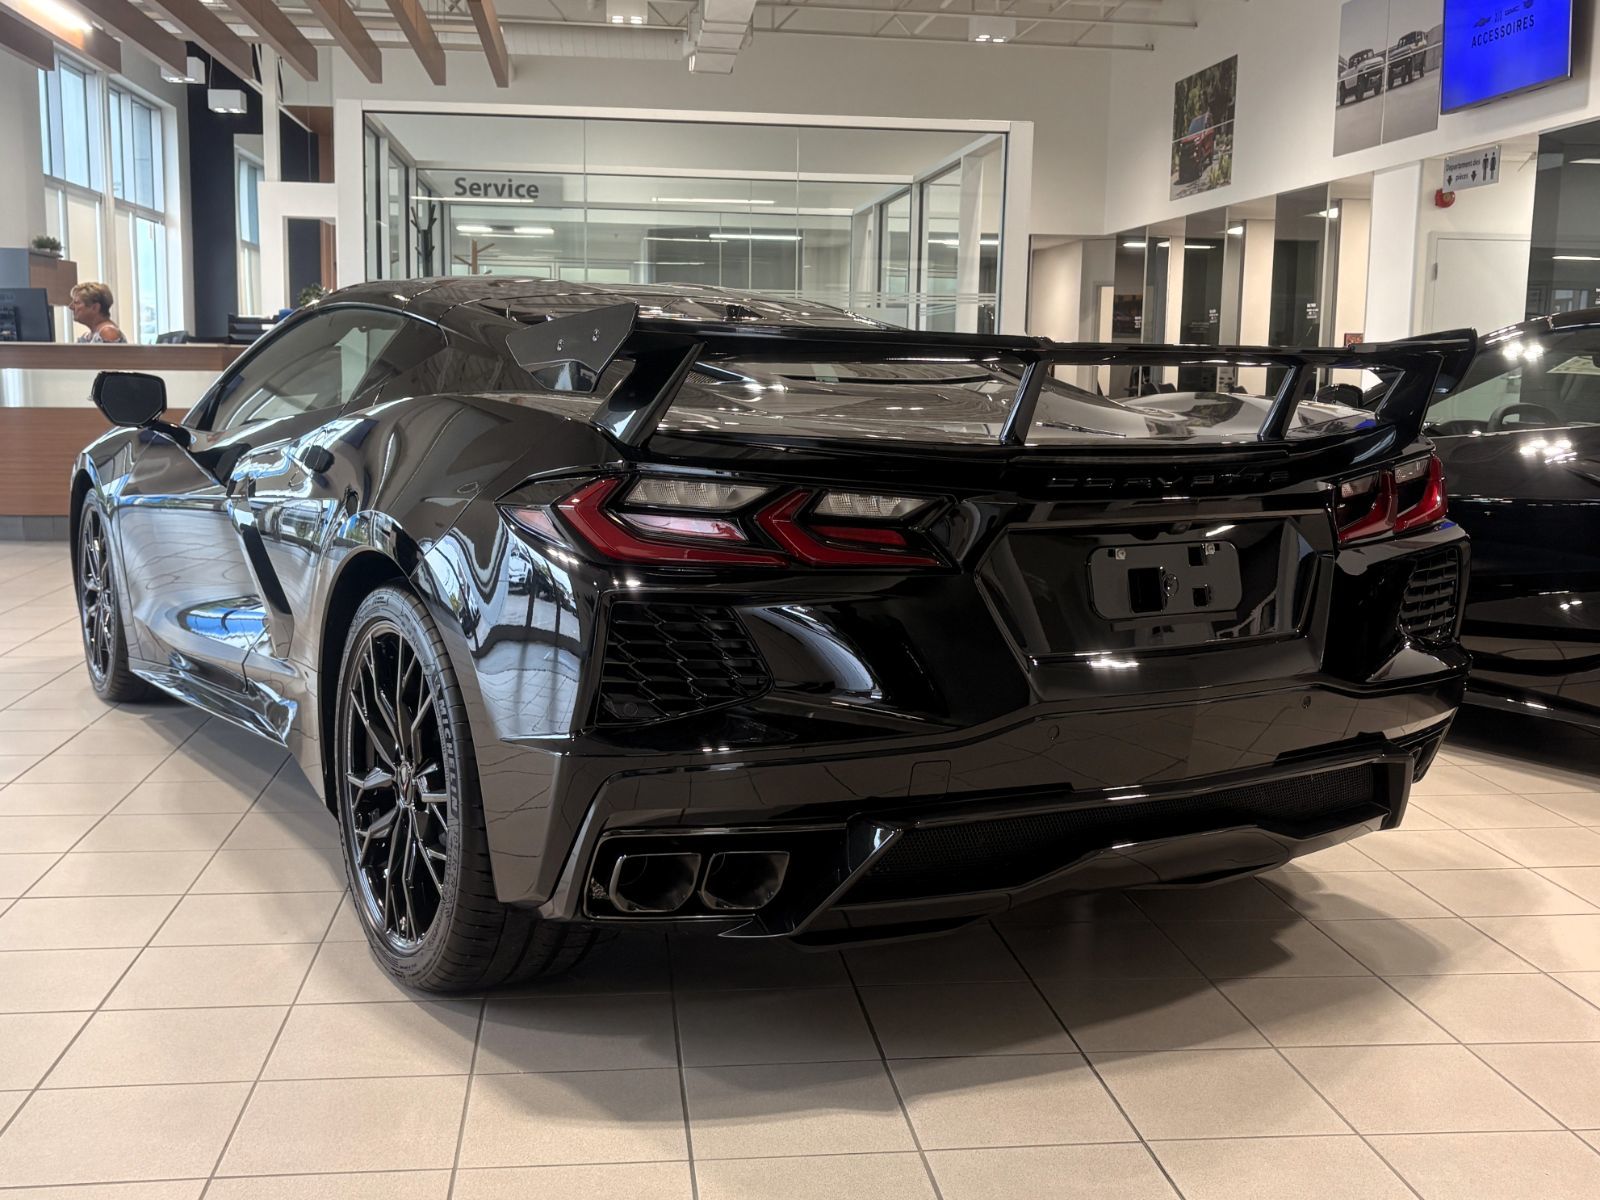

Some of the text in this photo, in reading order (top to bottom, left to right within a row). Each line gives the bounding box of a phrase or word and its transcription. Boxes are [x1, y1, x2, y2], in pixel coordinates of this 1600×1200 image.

[1471, 14, 1535, 48] ACCESSOIRES
[454, 177, 540, 198] Service
[438, 698, 459, 813] MICHELIN
